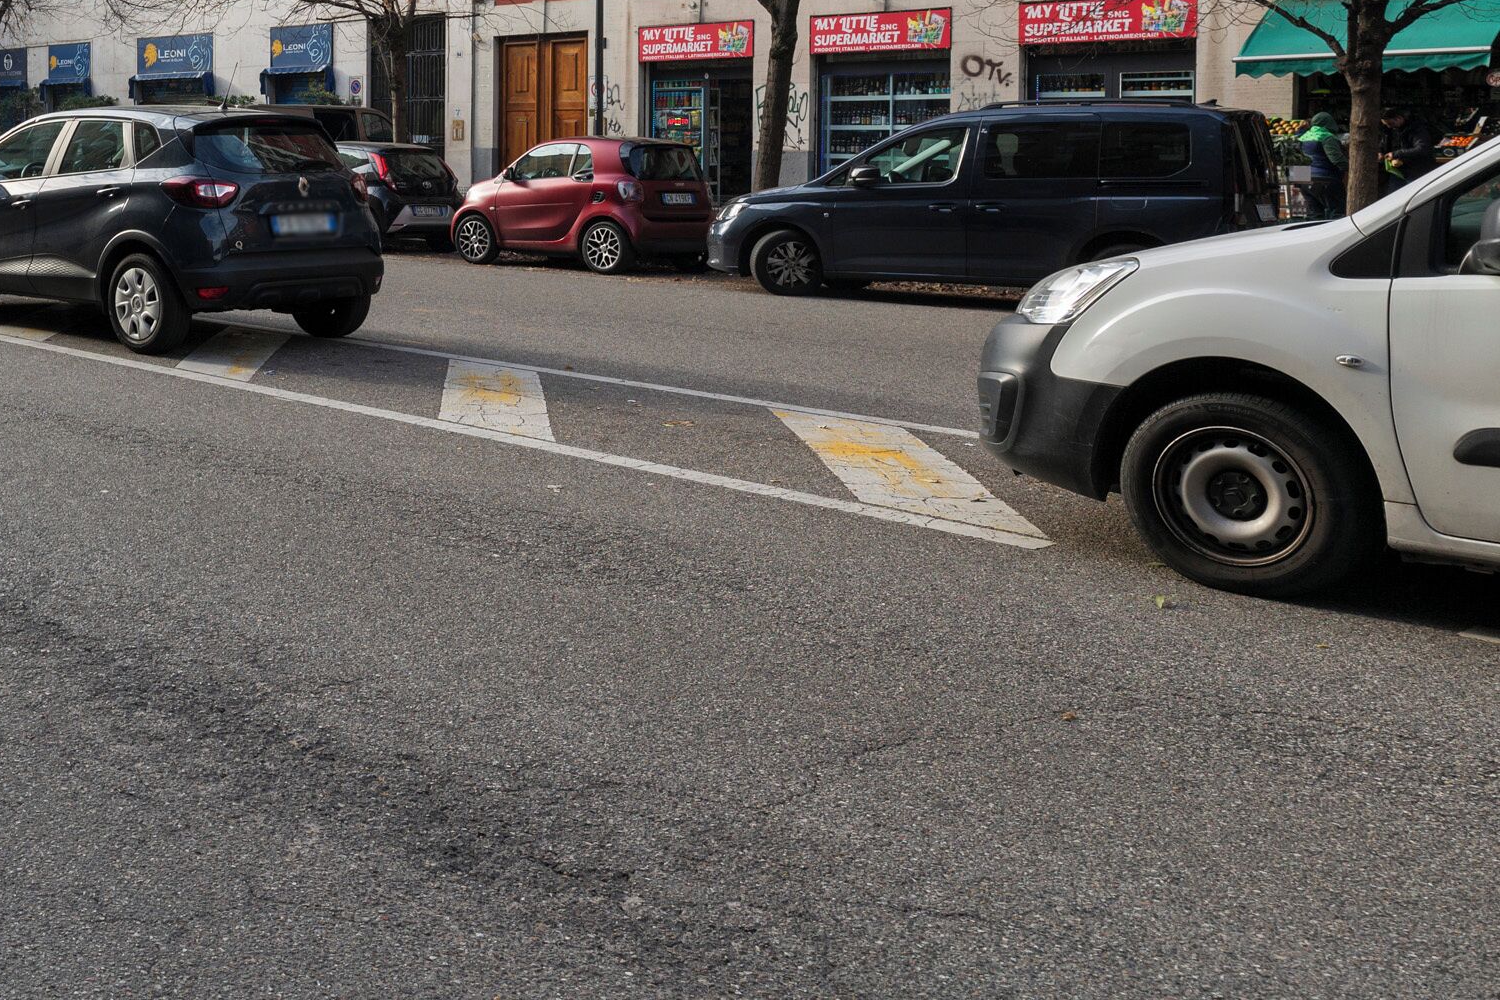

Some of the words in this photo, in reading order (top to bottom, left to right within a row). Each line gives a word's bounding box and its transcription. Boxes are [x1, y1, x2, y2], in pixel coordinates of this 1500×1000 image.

[1025, 5, 1053, 19] MY
[1056, 1, 1105, 21] LITTLE
[1107, 10, 1130, 18] SNC
[814, 18, 838, 31] MY
[840, 15, 878, 33] LITTLE
[1025, 18, 1132, 37] SUPERMARKET
[642, 28, 661, 41] MY
[663, 27, 695, 42] LITTLE
[814, 31, 900, 46] SUPERMARKET
[1094, 32, 1159, 41] LATINOAMERICANI
[158, 49, 186, 59] LEONI
[283, 43, 306, 51] LEONI
[642, 41, 713, 55] SUPERMARKET
